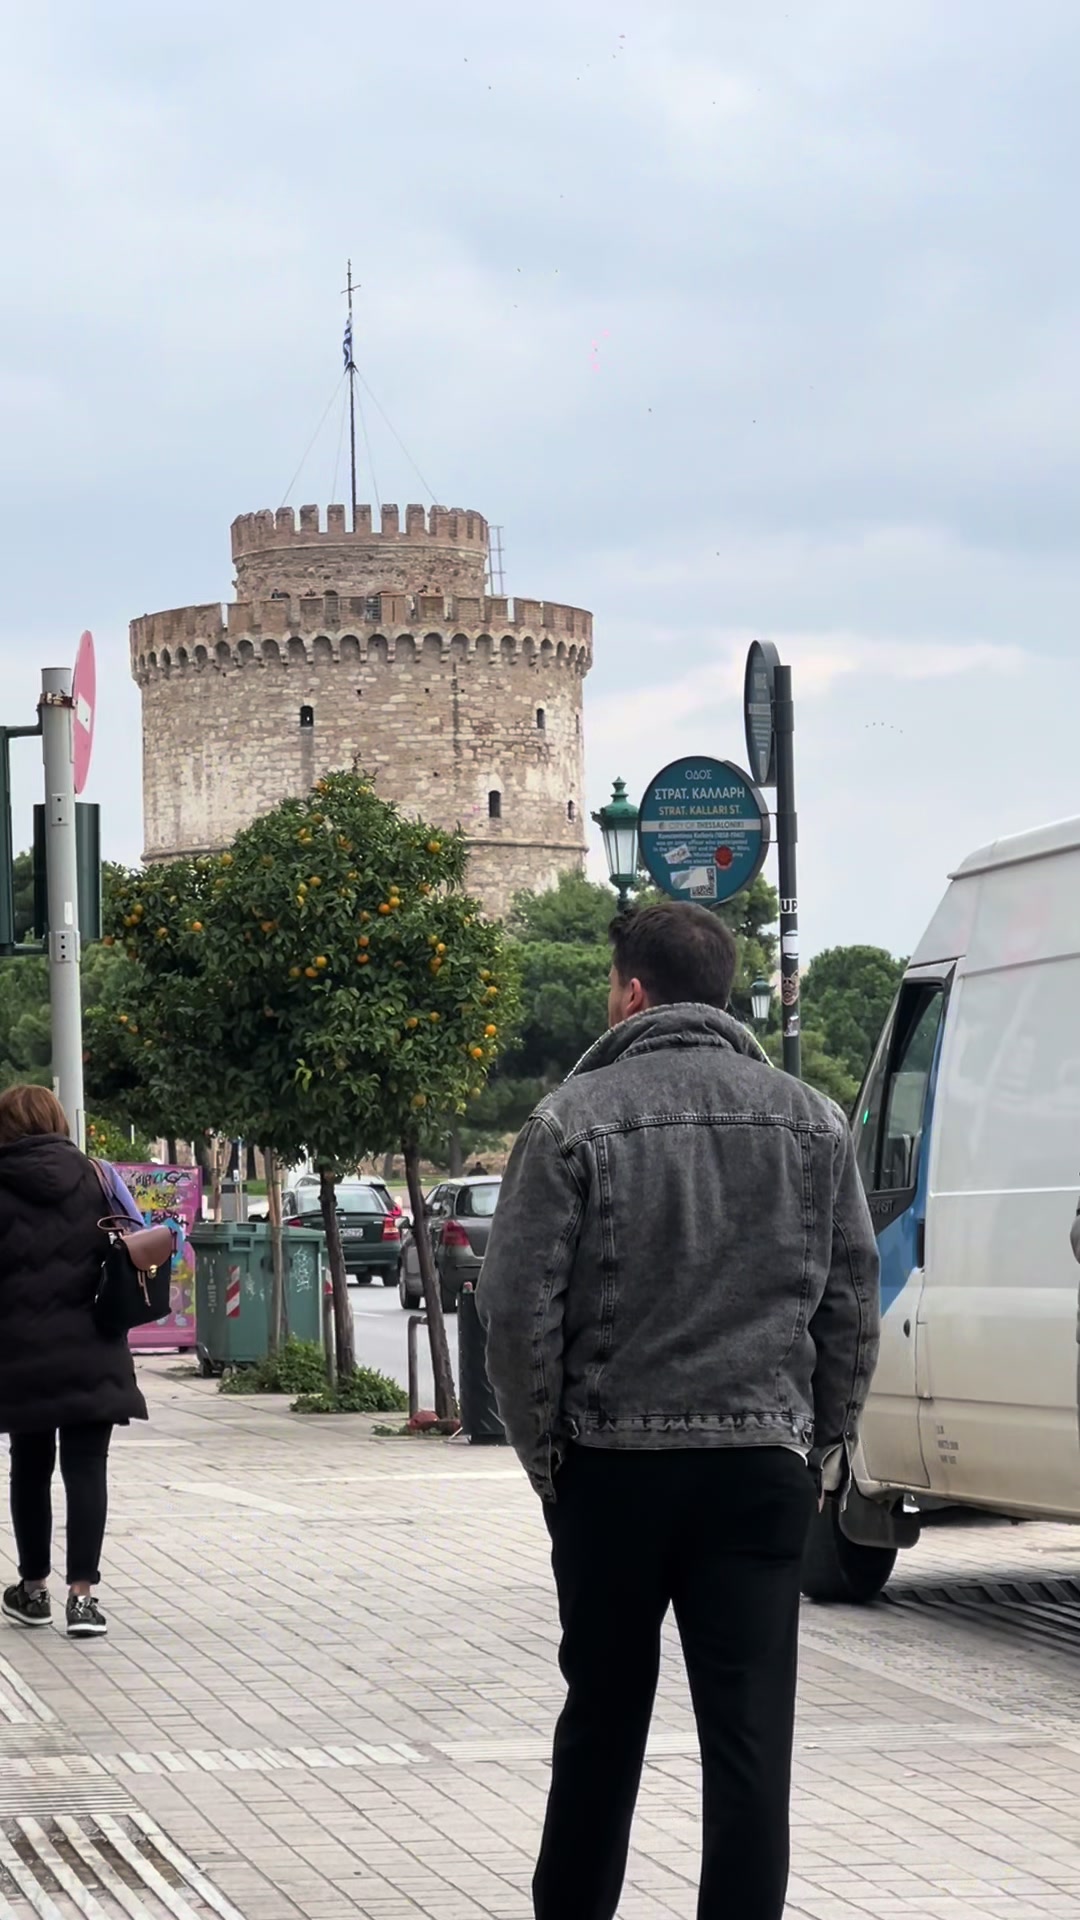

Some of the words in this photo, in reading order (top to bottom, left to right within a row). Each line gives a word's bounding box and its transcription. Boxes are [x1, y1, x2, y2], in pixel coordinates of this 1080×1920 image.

[685, 769, 713, 780] ΟΔΟΣ
[655, 788, 690, 800] ΣΤΡΑΤ.
[692, 787, 745, 799] ΚΑΛΛΑΡΗ
[659, 806, 688, 815] STRAT.
[689, 805, 728, 815] KALLARI
[729, 805, 743, 814] ST.
[696, 821, 745, 829] THESSALONIKI
